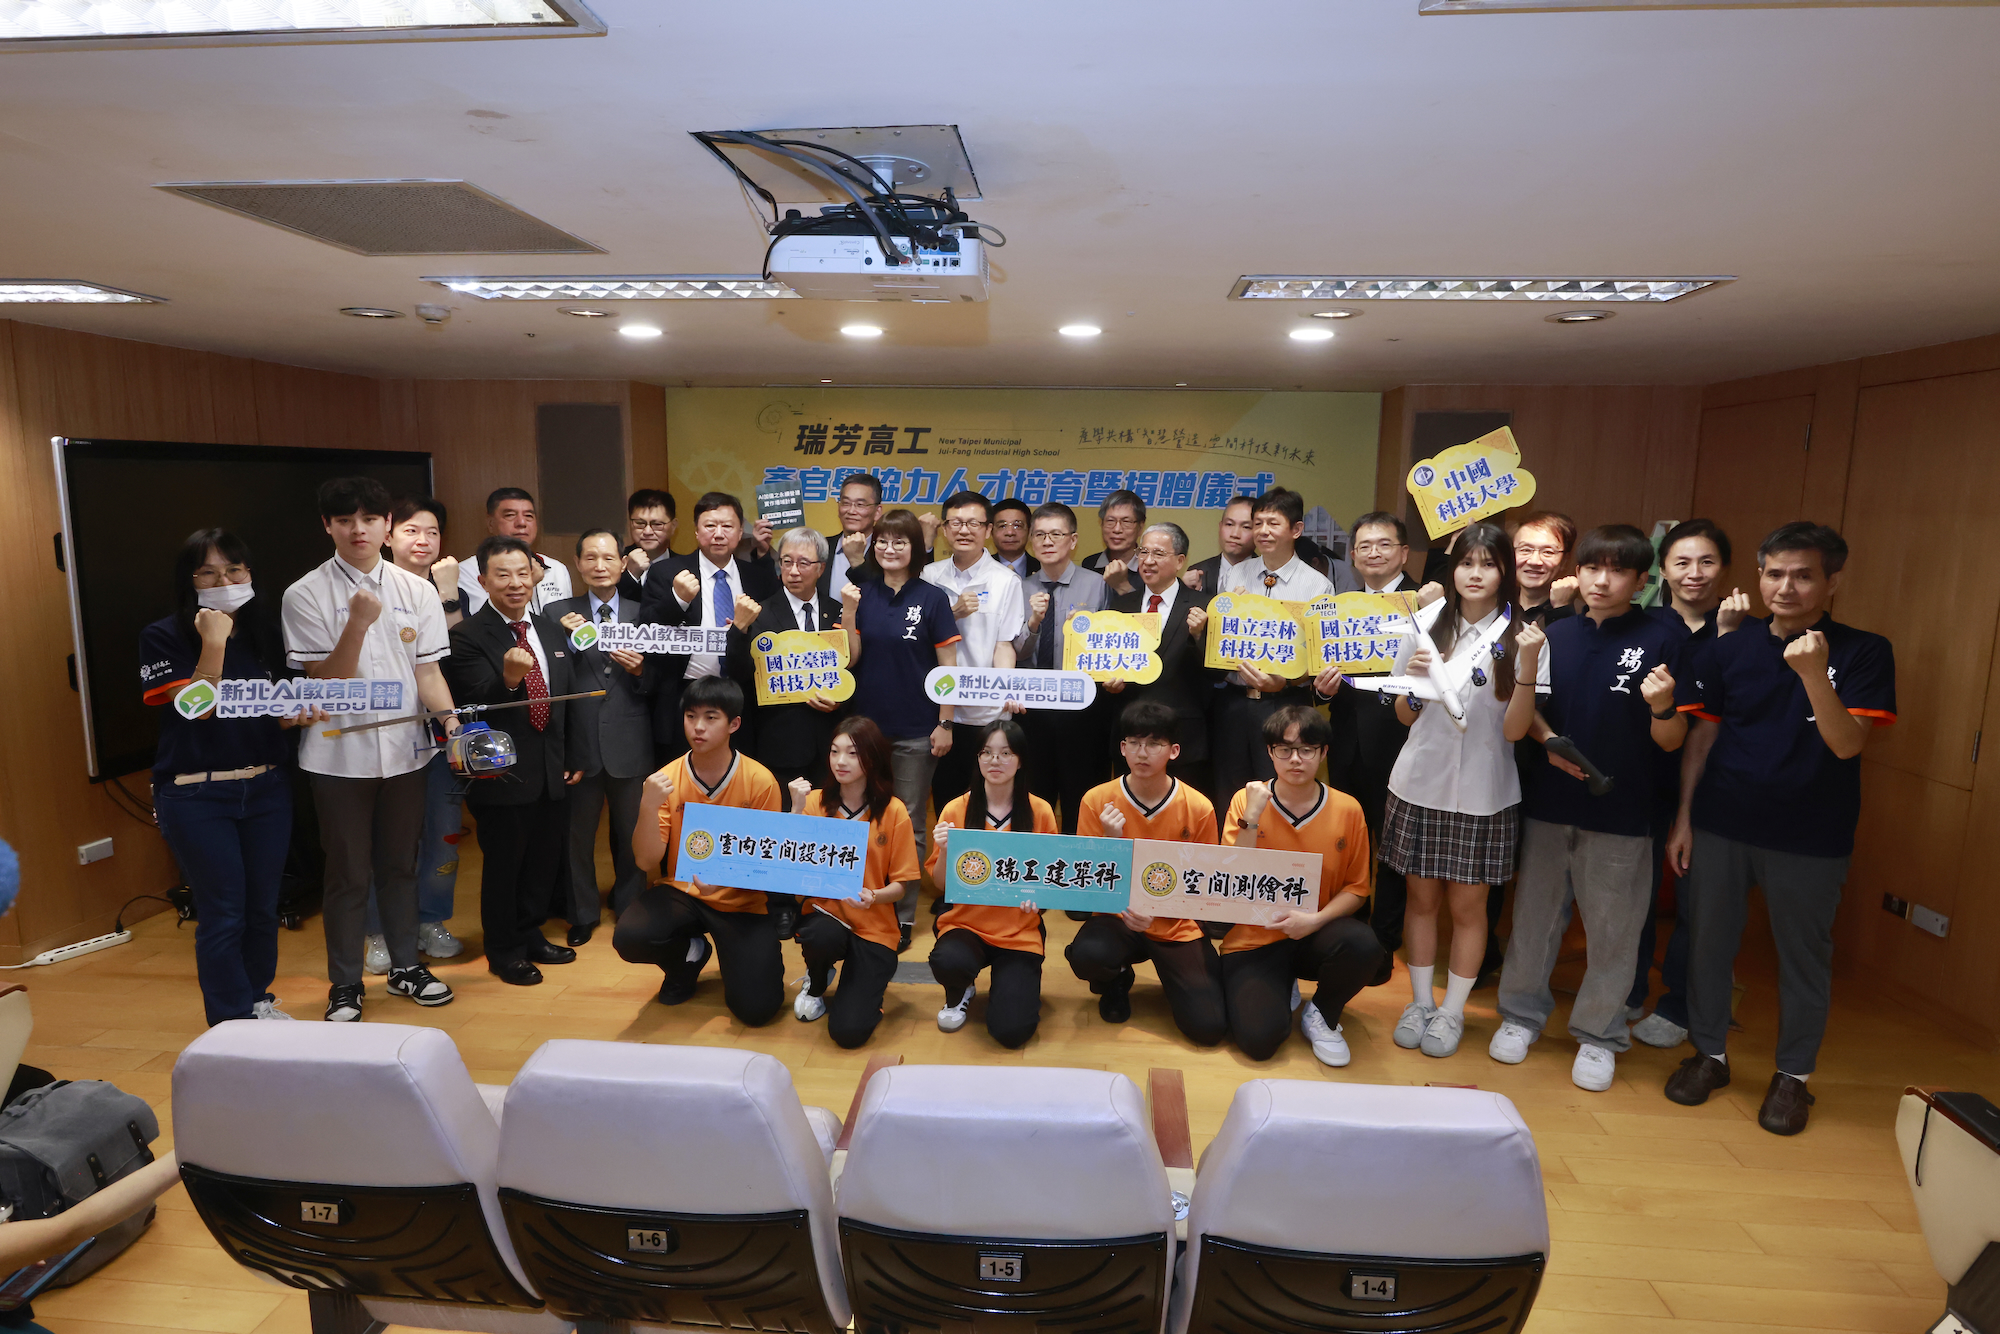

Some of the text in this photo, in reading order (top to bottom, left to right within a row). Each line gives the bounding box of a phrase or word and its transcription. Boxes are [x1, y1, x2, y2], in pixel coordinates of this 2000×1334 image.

[794, 424, 932, 456] 瑞芳高工
[958, 438, 982, 446] Taipei
[983, 438, 1022, 447] Municipal
[938, 448, 1061, 457] Jui-Fang Industrial High School
[1444, 458, 1492, 491] 中國
[1437, 474, 1518, 522] 科技大學
[1310, 602, 1336, 610] TAIPEI
[902, 605, 922, 641] 瑞工
[1222, 616, 1297, 640] 國立雲林
[601, 642, 704, 652] NTPC AI EDU
[1086, 632, 1140, 650] 聖約翰
[1220, 639, 1295, 663] 科技大學
[766, 650, 839, 672] 國立臺灣
[1077, 653, 1149, 672] 科技大學
[1609, 647, 1646, 695] 瑞工
[374, 684, 400, 696] 全球
[769, 671, 840, 693] 科技大學
[1062, 680, 1083, 690] 全球
[374, 696, 399, 708] 首推
[959, 691, 1057, 702] NTPC AI EDU
[1062, 691, 1082, 701] 首推
[221, 704, 285, 714] NTPC
[322, 702, 366, 711] EDU
[995, 857, 1122, 891] 瑞工建築科
[1182, 870, 1309, 906] 空間測繪科
[309, 1206, 332, 1220] 1-7
[636, 1232, 661, 1247] 1-6
[989, 1261, 1015, 1277] 1-5
[1361, 1279, 1388, 1295] 1-4
